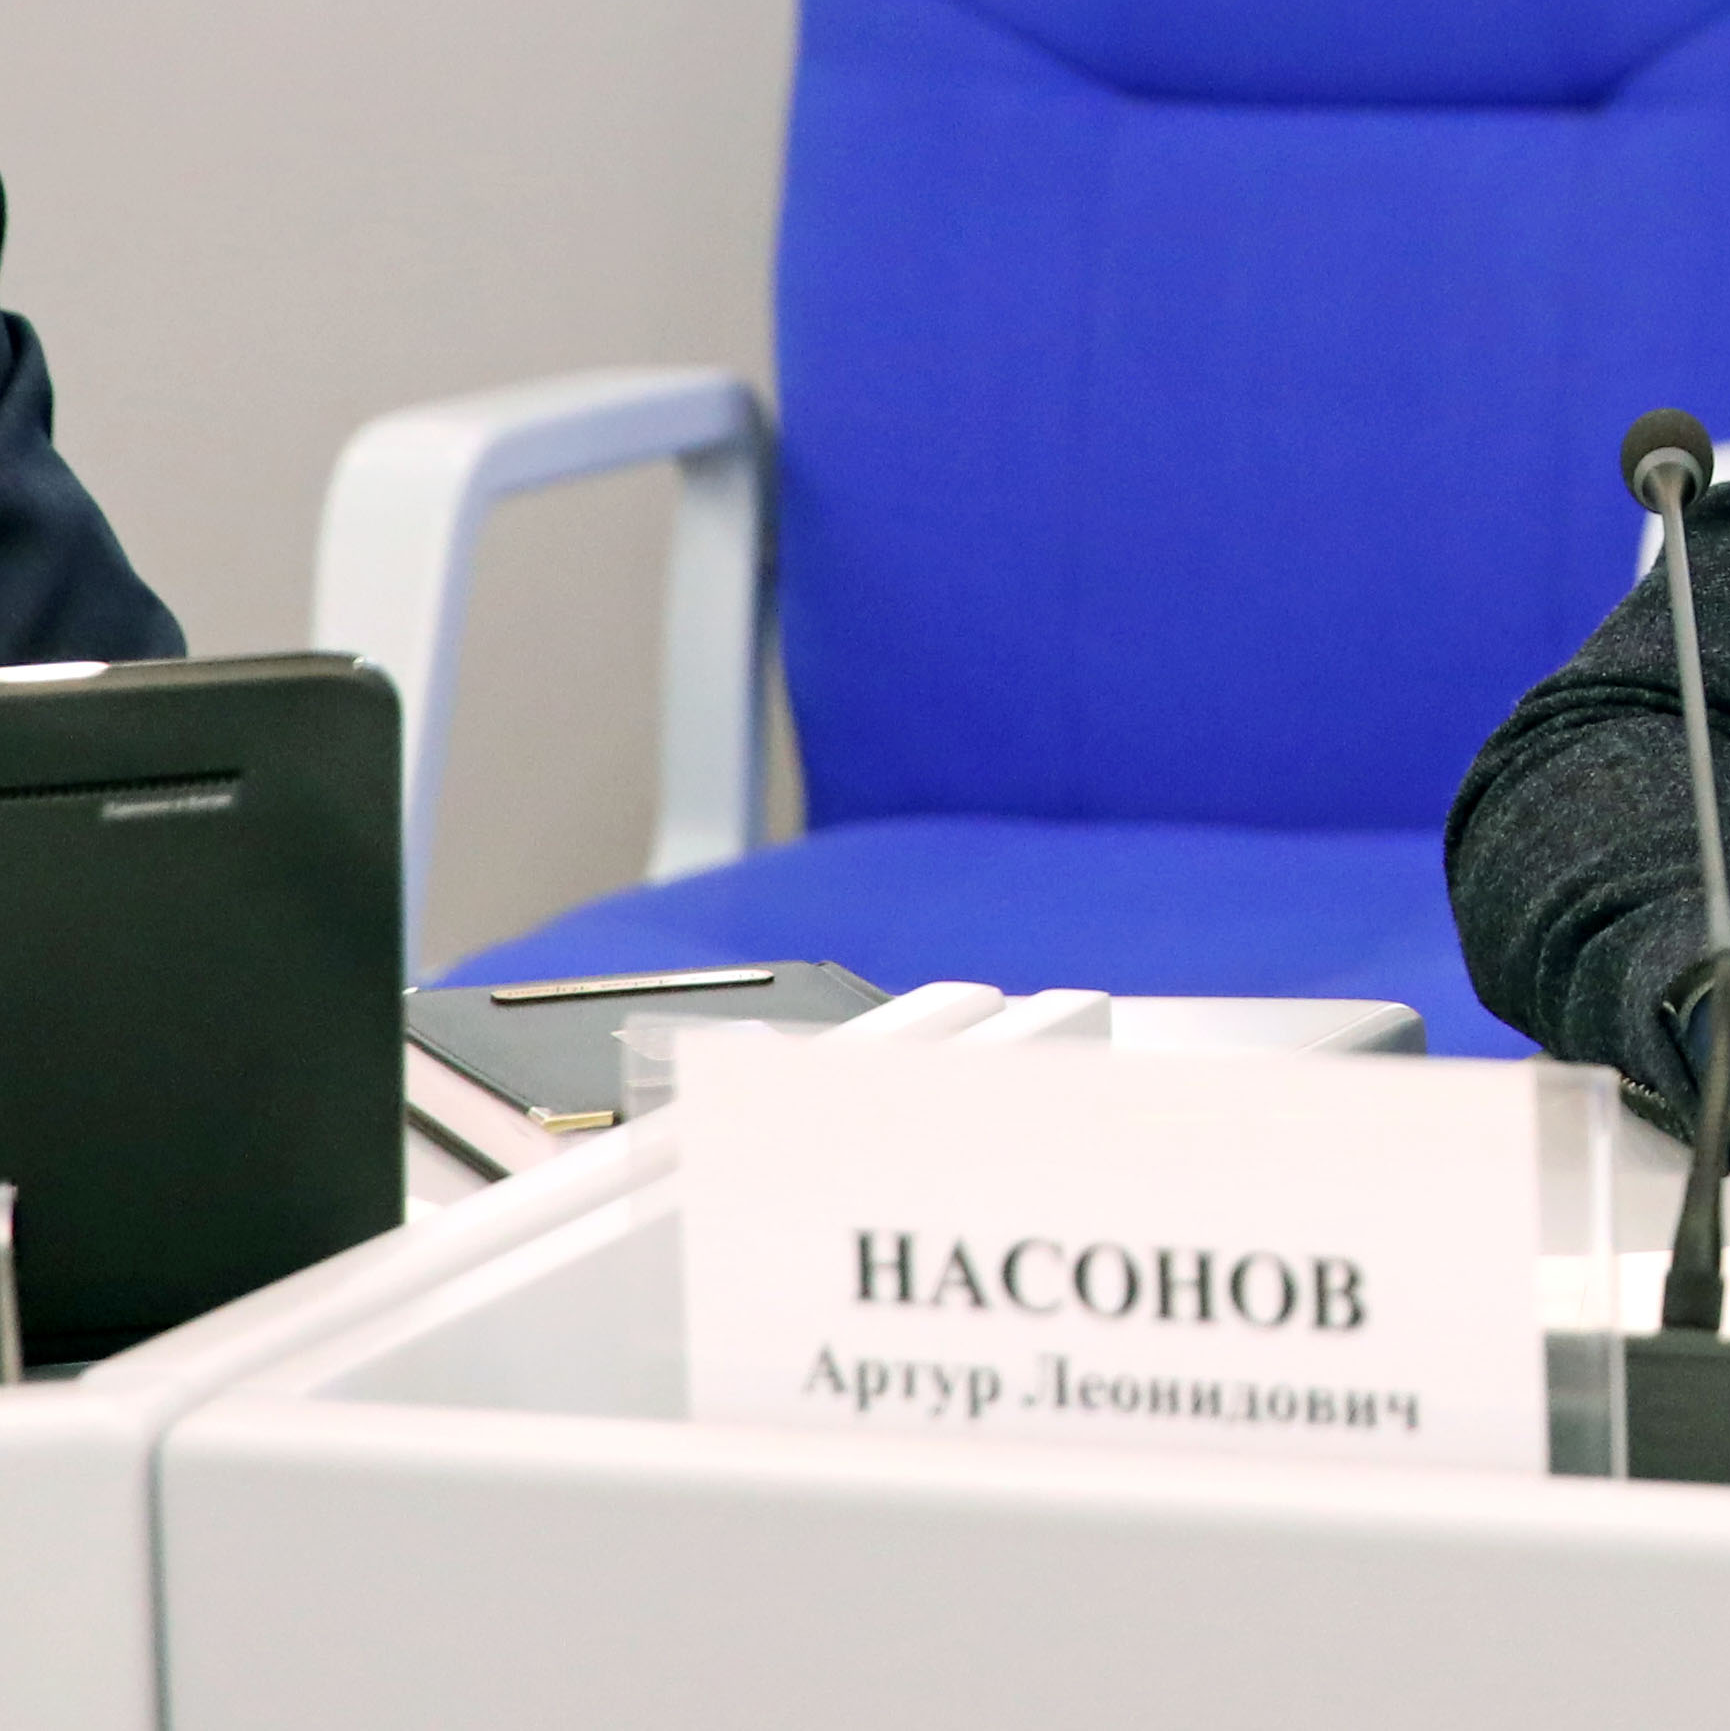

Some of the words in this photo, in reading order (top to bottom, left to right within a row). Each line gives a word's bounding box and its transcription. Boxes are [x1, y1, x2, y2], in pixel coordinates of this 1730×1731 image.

[855, 1229, 1368, 1333] НАСОНОВ
[804, 1345, 1003, 1420] Артур
[1022, 1354, 1421, 1433] Леонидович
